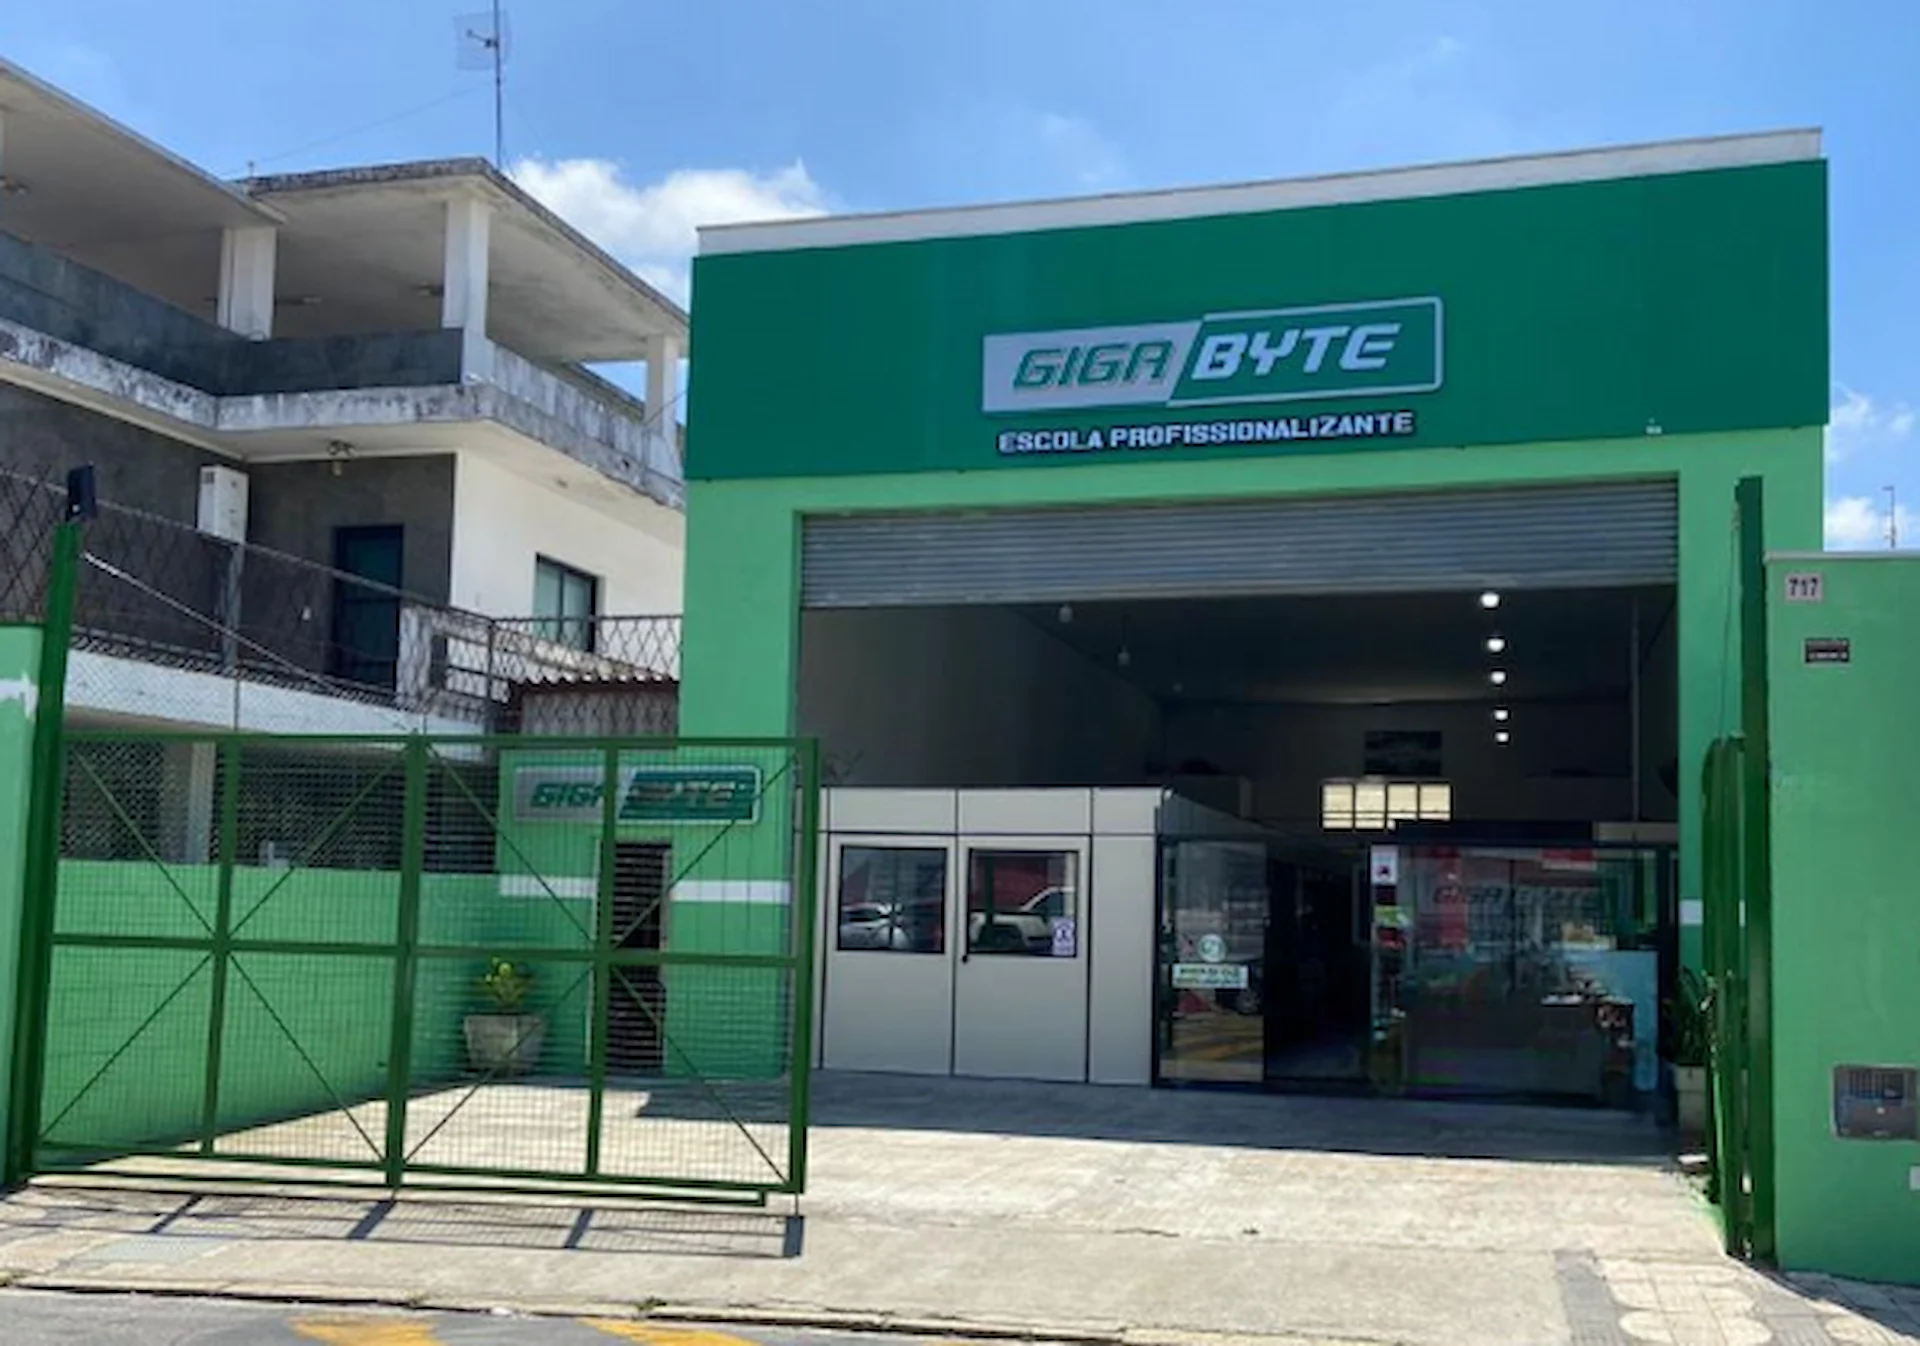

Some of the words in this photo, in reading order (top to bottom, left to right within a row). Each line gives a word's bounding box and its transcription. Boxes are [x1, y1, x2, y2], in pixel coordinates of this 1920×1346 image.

[1013, 340, 1174, 388] GIGA
[1191, 322, 1402, 380] BYTE
[1000, 429, 1104, 453] ESCOLA
[1110, 411, 1414, 448] PROFISSIONALIZANTE
[1788, 577, 1818, 597] 717
